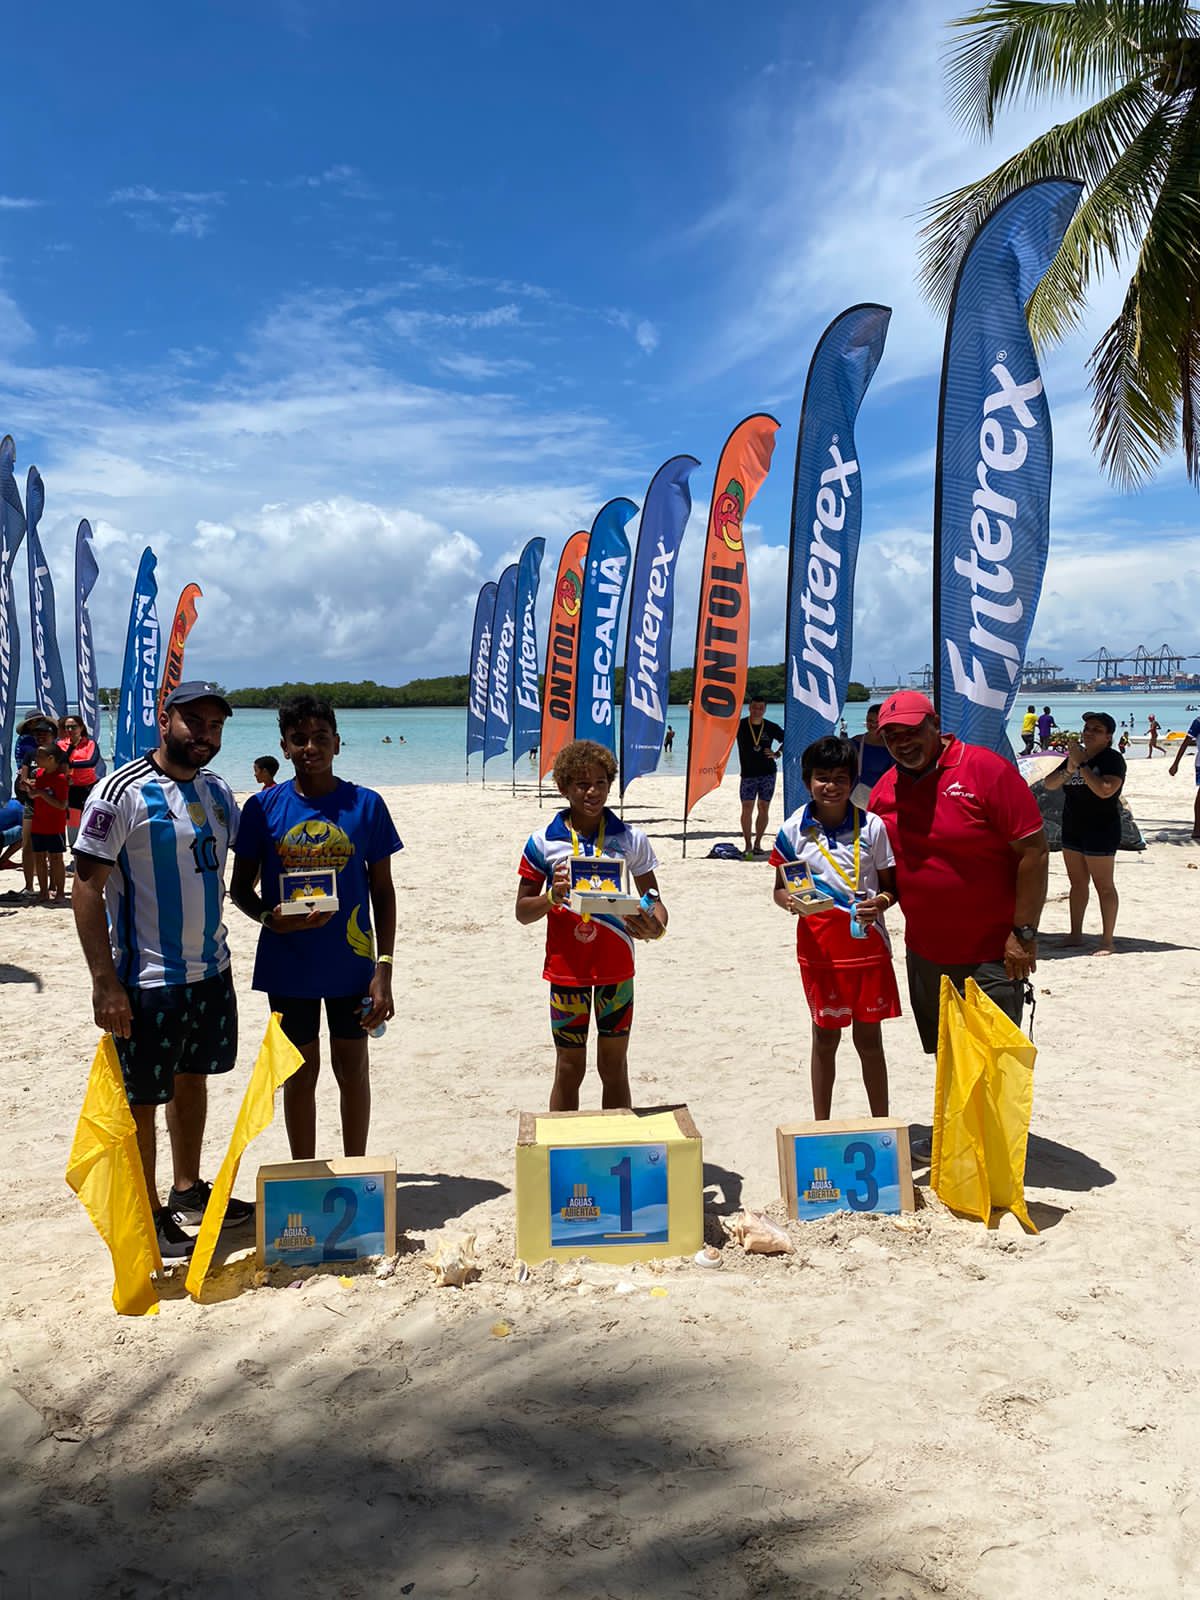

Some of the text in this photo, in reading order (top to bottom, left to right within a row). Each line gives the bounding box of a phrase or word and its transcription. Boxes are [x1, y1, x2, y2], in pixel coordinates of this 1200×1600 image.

[945, 363, 1043, 711] Enterex
[791, 444, 859, 724] Enterex
[489, 614, 516, 725] Enterex
[515, 594, 541, 712] Enterex
[591, 555, 628, 726] SECALIA
[629, 542, 675, 724] Enterex
[701, 561, 745, 719] ONTOL
[469, 625, 493, 722] Enterex
[549, 623, 576, 722] ONTOL
[188, 835, 220, 874] 10
[564, 1207, 598, 1217] ABIERTAS
[569, 1198, 592, 1207] AGUAS
[609, 1156, 632, 1232] 1
[807, 1189, 838, 1199] ABIERTAS
[811, 1181, 832, 1189] AGUAS
[843, 1141, 879, 1211] 3
[278, 1236, 313, 1247] ABIERTAS
[283, 1227, 307, 1237] AGUAS
[322, 1186, 358, 1260] 2
